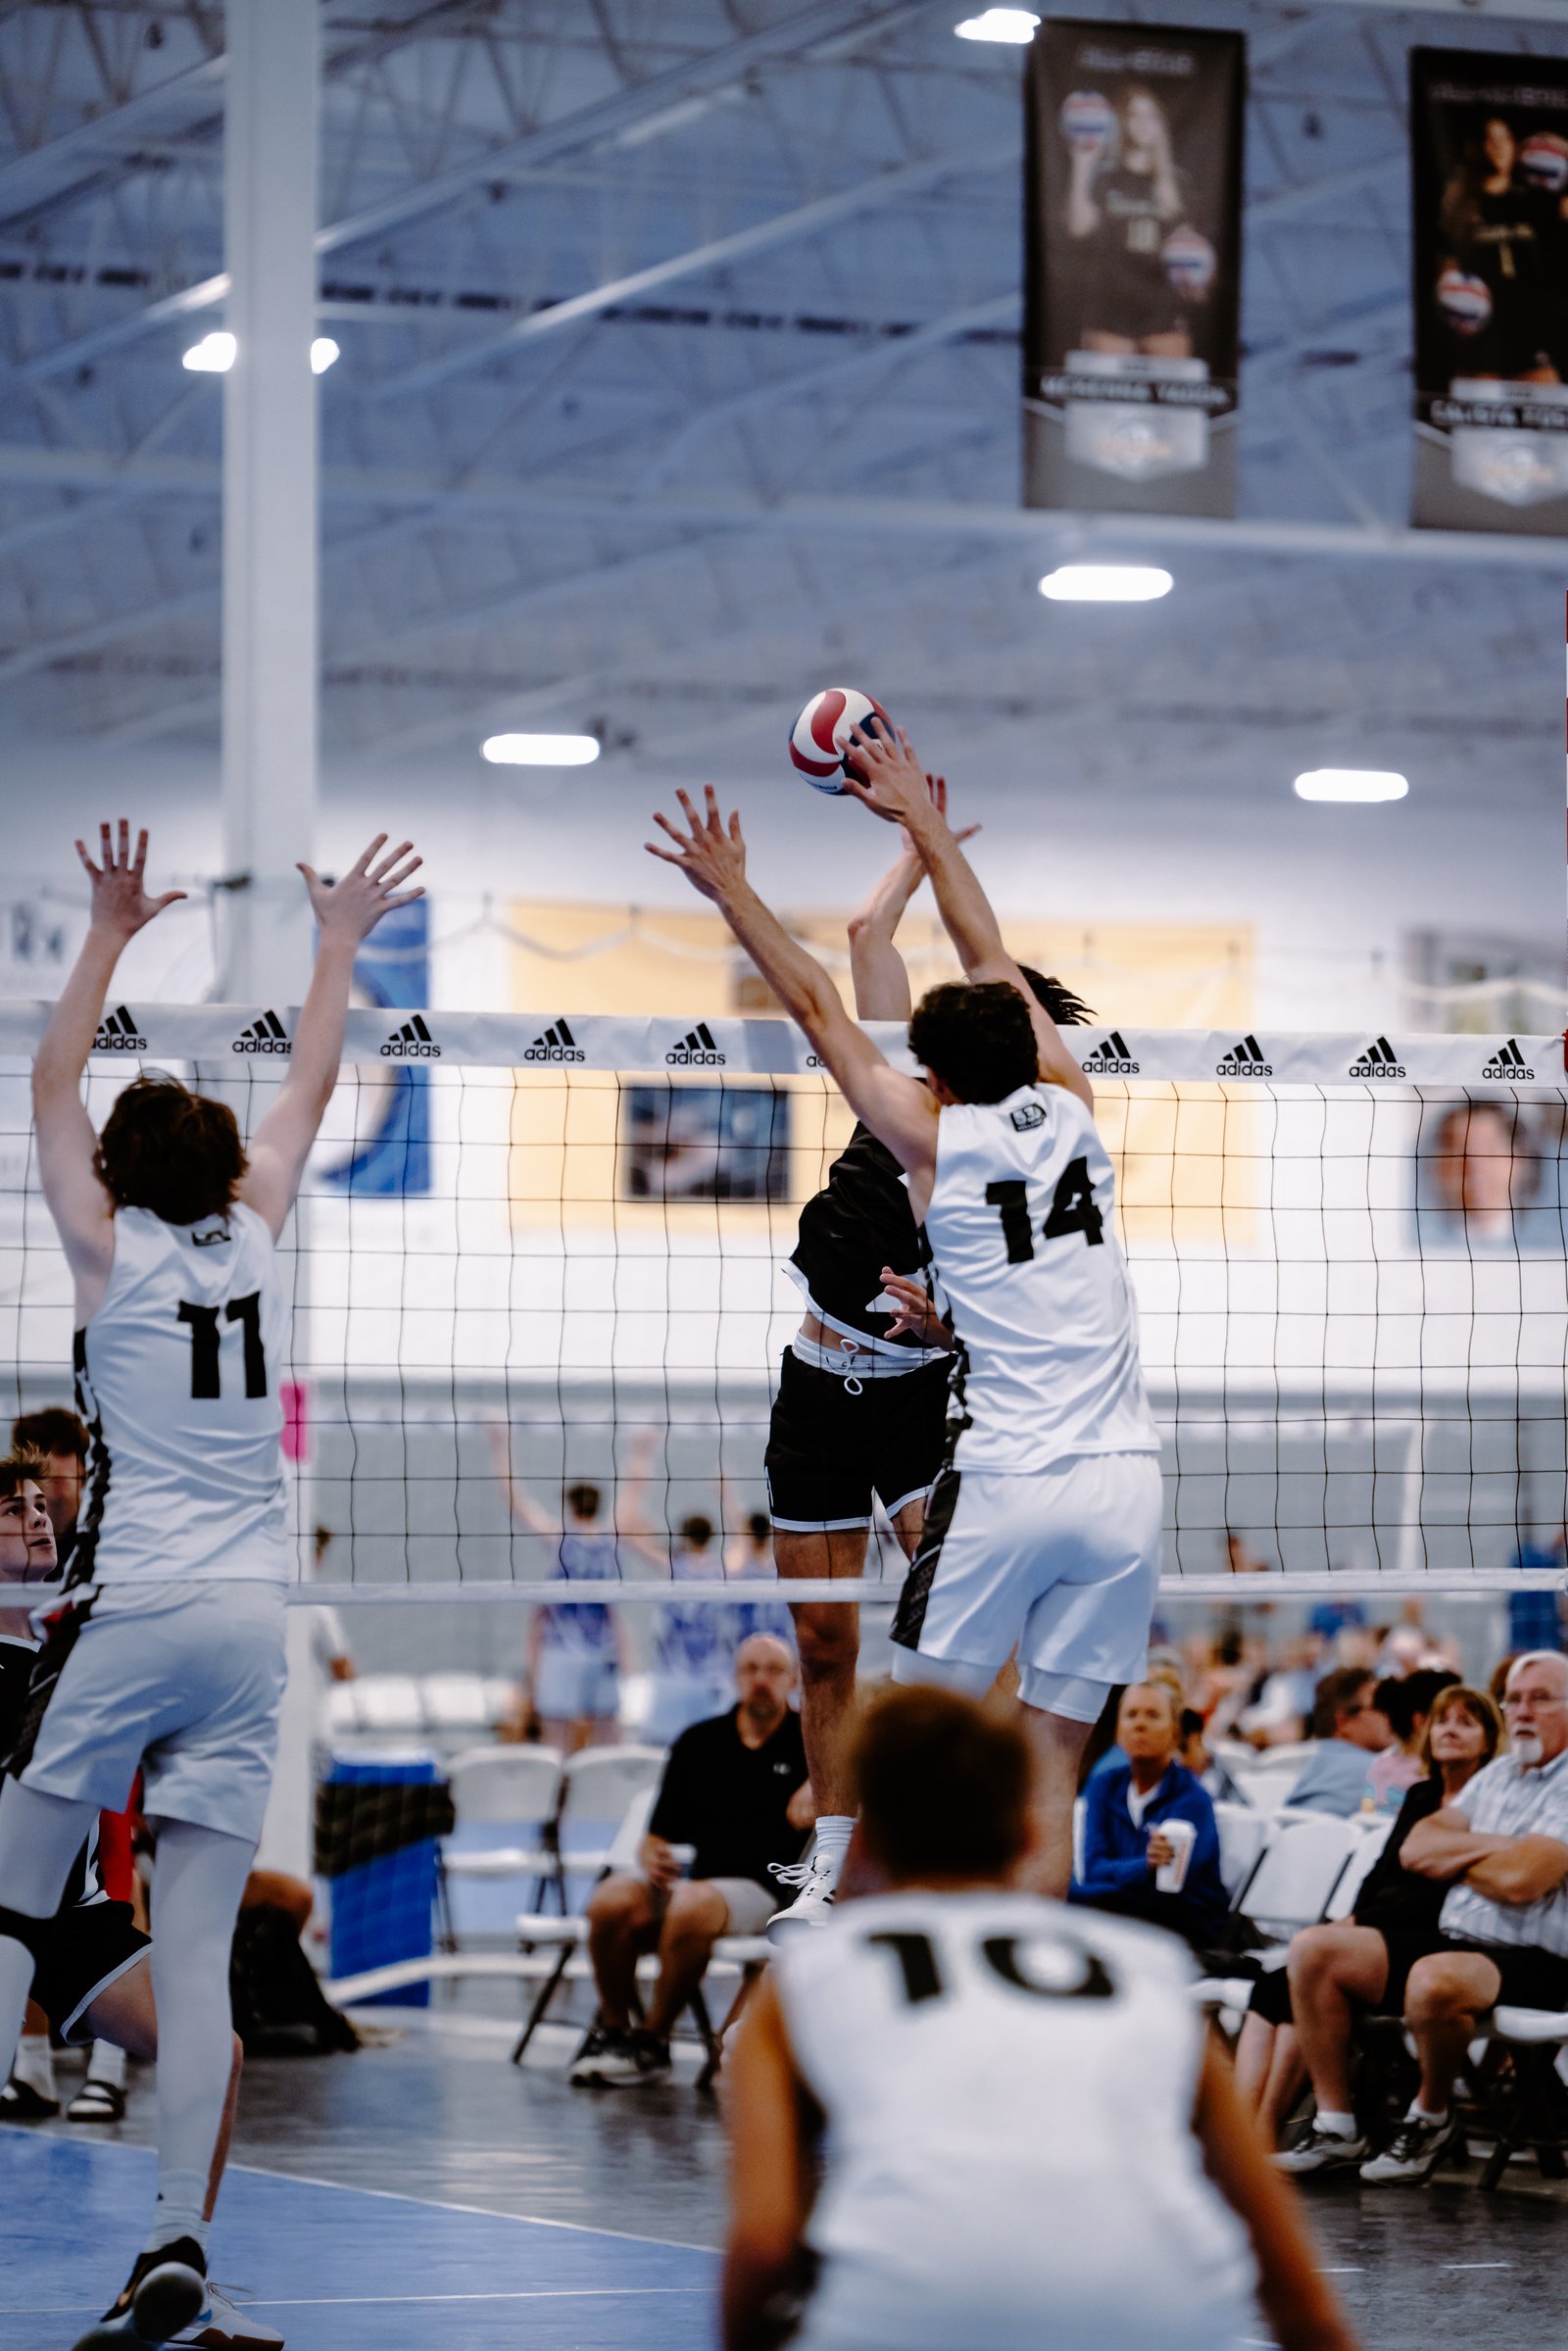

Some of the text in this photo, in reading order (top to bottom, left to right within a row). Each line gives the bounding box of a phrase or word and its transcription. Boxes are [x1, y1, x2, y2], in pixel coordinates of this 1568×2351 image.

[232, 1039, 292, 1053] adidas
[380, 1041, 441, 1057] adidas
[524, 1045, 585, 1062] adidas
[665, 1048, 726, 1065] adidas
[1082, 1058, 1140, 1074] adidas
[1216, 1060, 1273, 1076] adidas
[1348, 1062, 1406, 1078] adidas
[1482, 1064, 1535, 1080] adidas
[986, 1156, 1103, 1264] 14
[177, 1291, 267, 1399] 11
[868, 1933, 1115, 2002] 10
